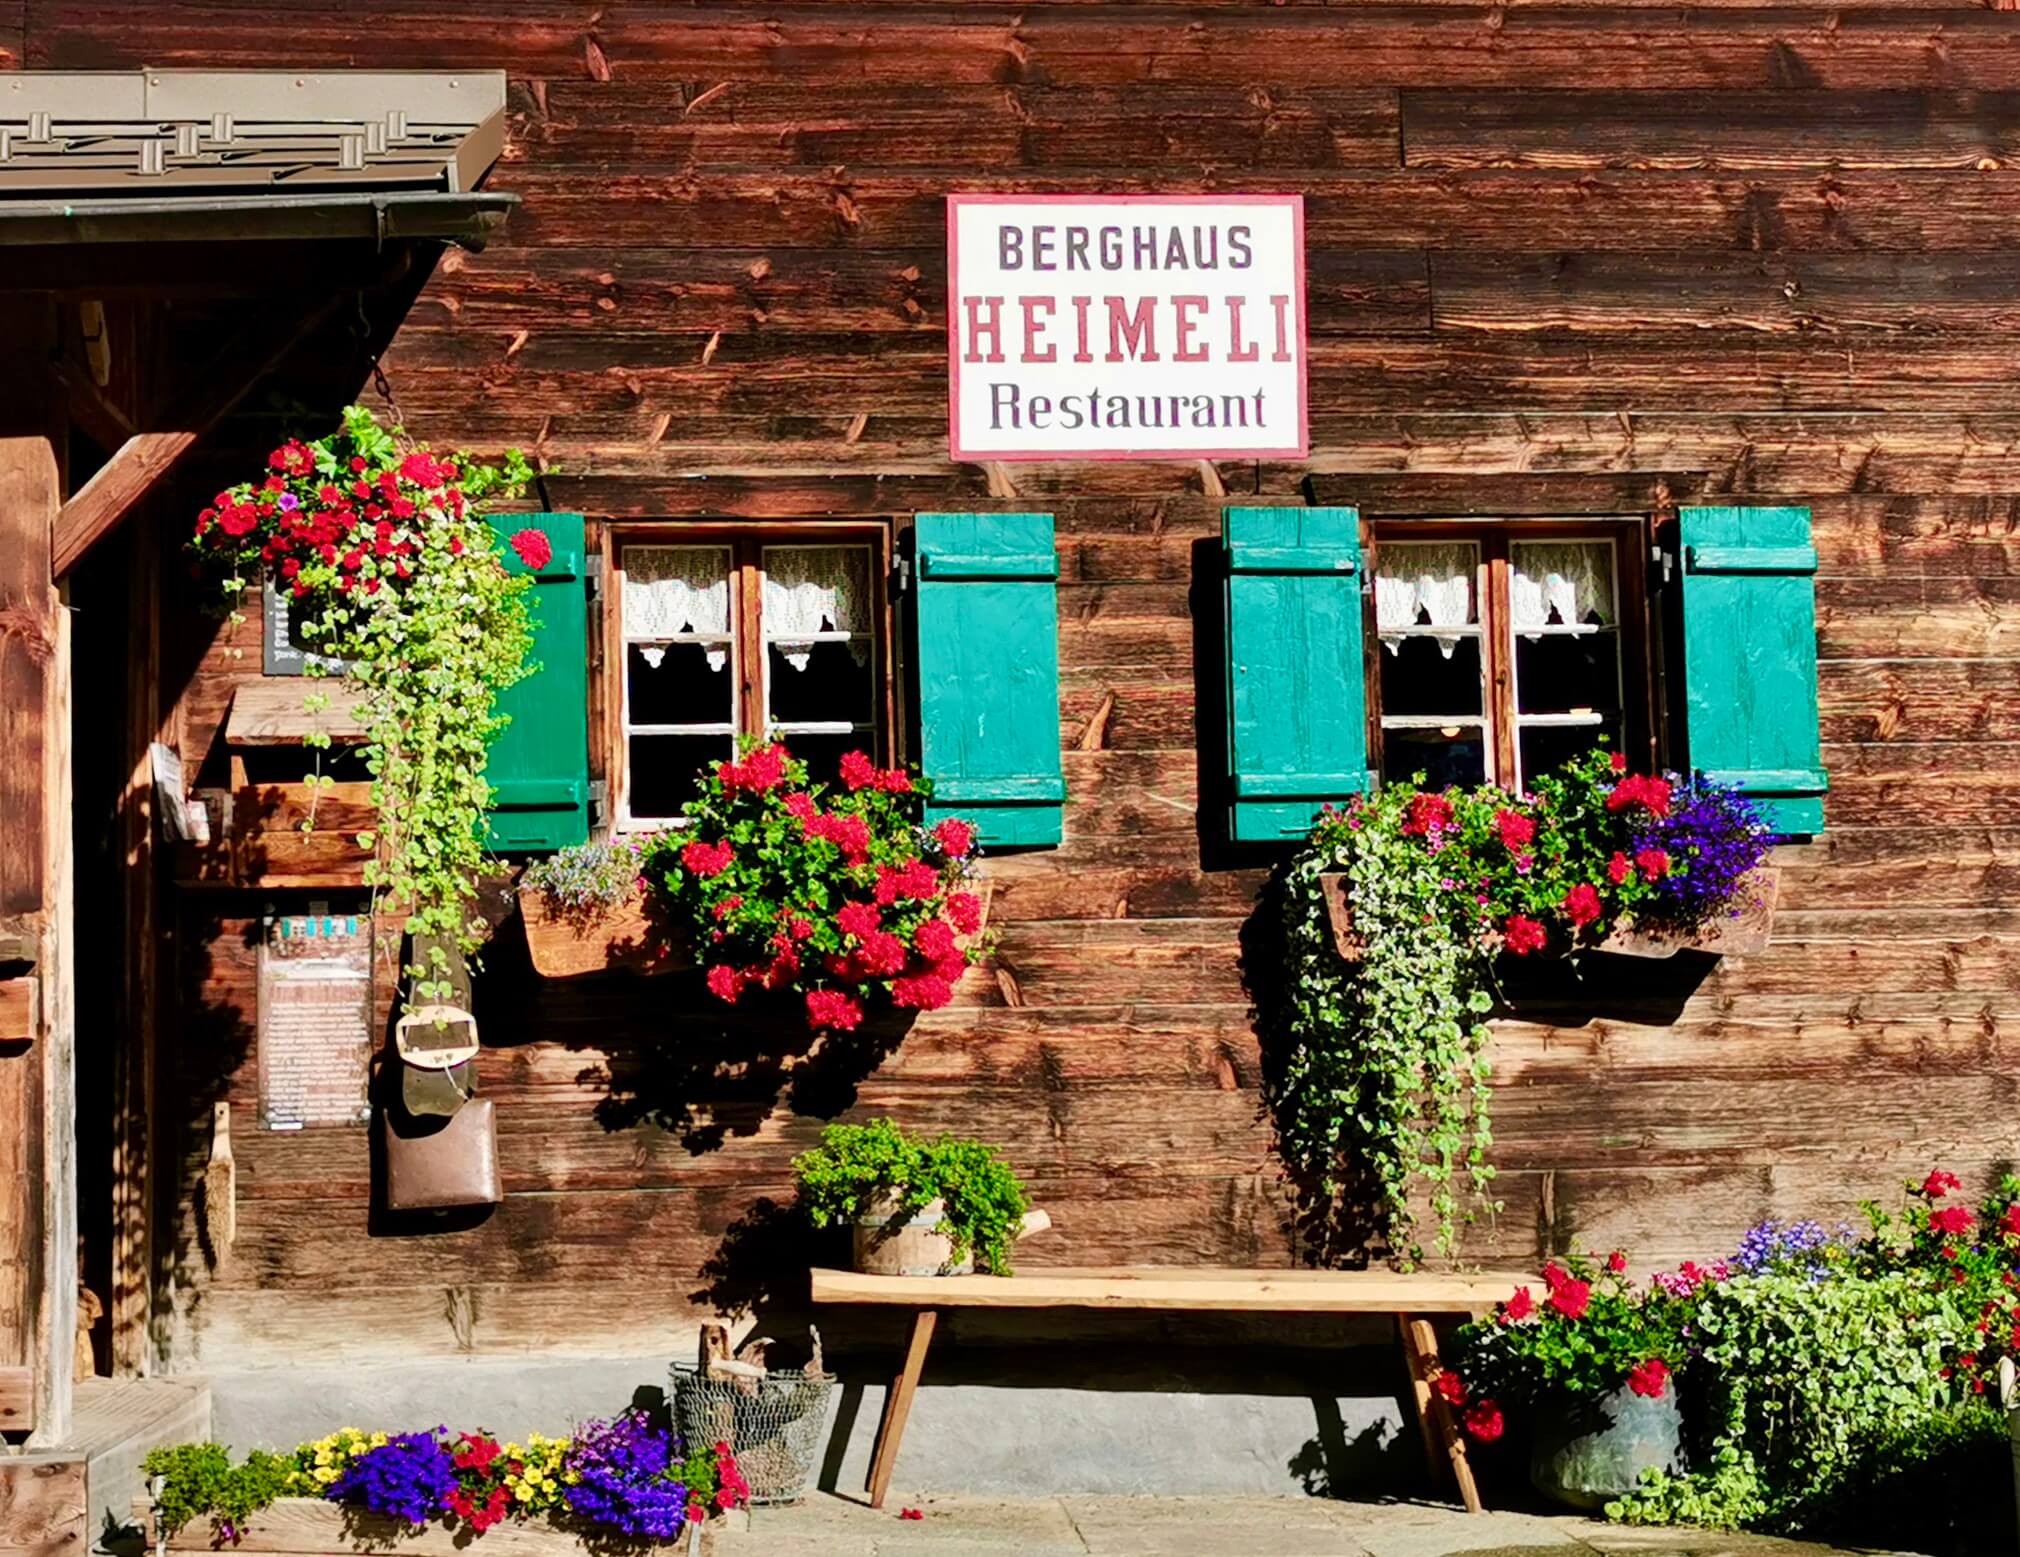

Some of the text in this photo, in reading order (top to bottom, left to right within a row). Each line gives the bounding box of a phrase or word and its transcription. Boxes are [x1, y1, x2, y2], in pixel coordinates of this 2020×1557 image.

[999, 225, 1252, 271] BERGHAUS
[963, 295, 1292, 363] HEIMELI
[988, 383, 1267, 430] Restaurant
